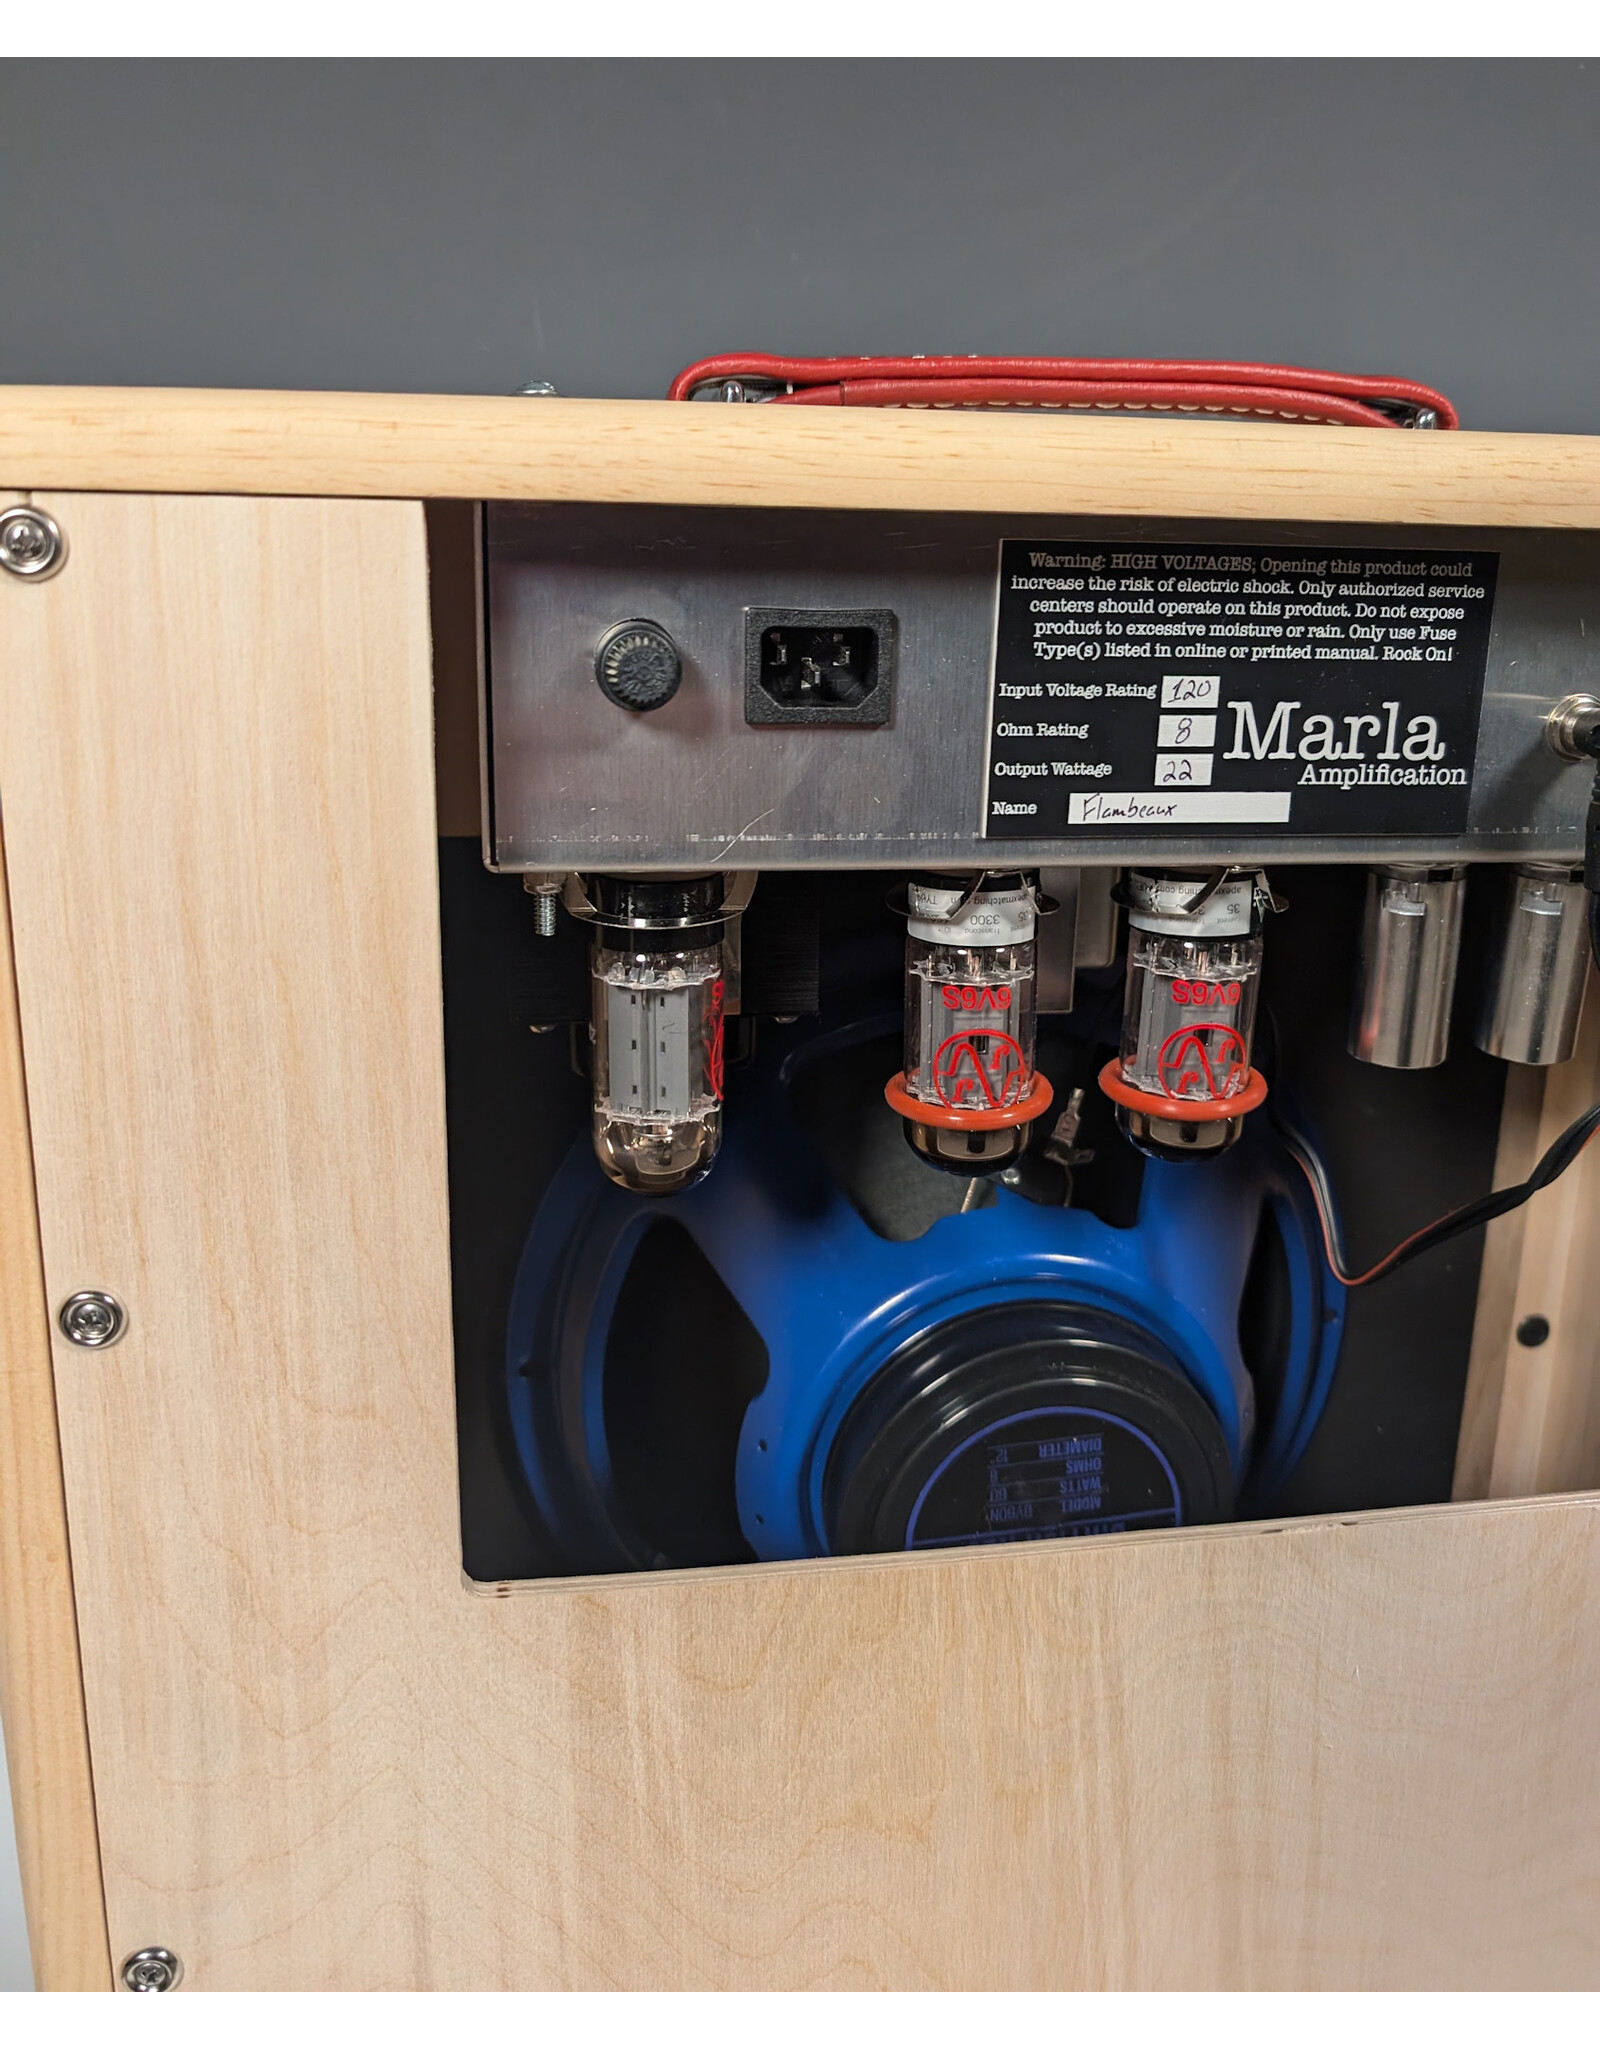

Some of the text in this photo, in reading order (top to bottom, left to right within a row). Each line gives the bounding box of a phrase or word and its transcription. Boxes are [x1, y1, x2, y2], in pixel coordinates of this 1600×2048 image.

[1029, 552, 1472, 577] Warning: HIGH VOLTAGES; Opening this product could
[1010, 575, 1485, 599] increase the risk of electric shock. Only authorized service
[1029, 598, 1464, 622] centers should operate on this product. Do not expose
[1033, 620, 1457, 643] product to excessive moisture or rain. Only use Fuse
[1033, 641, 1453, 662] Type(s) listed in online or printed manual. Rock On!
[998, 683, 1158, 700] Input Voltage Rating
[1167, 678, 1212, 703] 120
[996, 722, 1089, 739] Ohm Rating
[1175, 717, 1192, 744] 8
[1223, 701, 1446, 761] Marla
[994, 762, 1113, 778] Output Wattage
[1163, 759, 1192, 782] 22
[1297, 763, 1467, 790] Amplification
[991, 801, 1037, 815] Name
[1083, 792, 1178, 821] Flambeaux
[970, 914, 1000, 926] 3300
[1227, 904, 1240, 915] 35
[942, 984, 1011, 1011] 6V6S
[1172, 979, 1241, 1005] 6V6S
[1038, 1436, 1102, 1459] DIAMETER
[1066, 1457, 1101, 1475] OHMS
[1060, 1476, 1101, 1495] WATTS
[1061, 1496, 1101, 1514] MODEL
